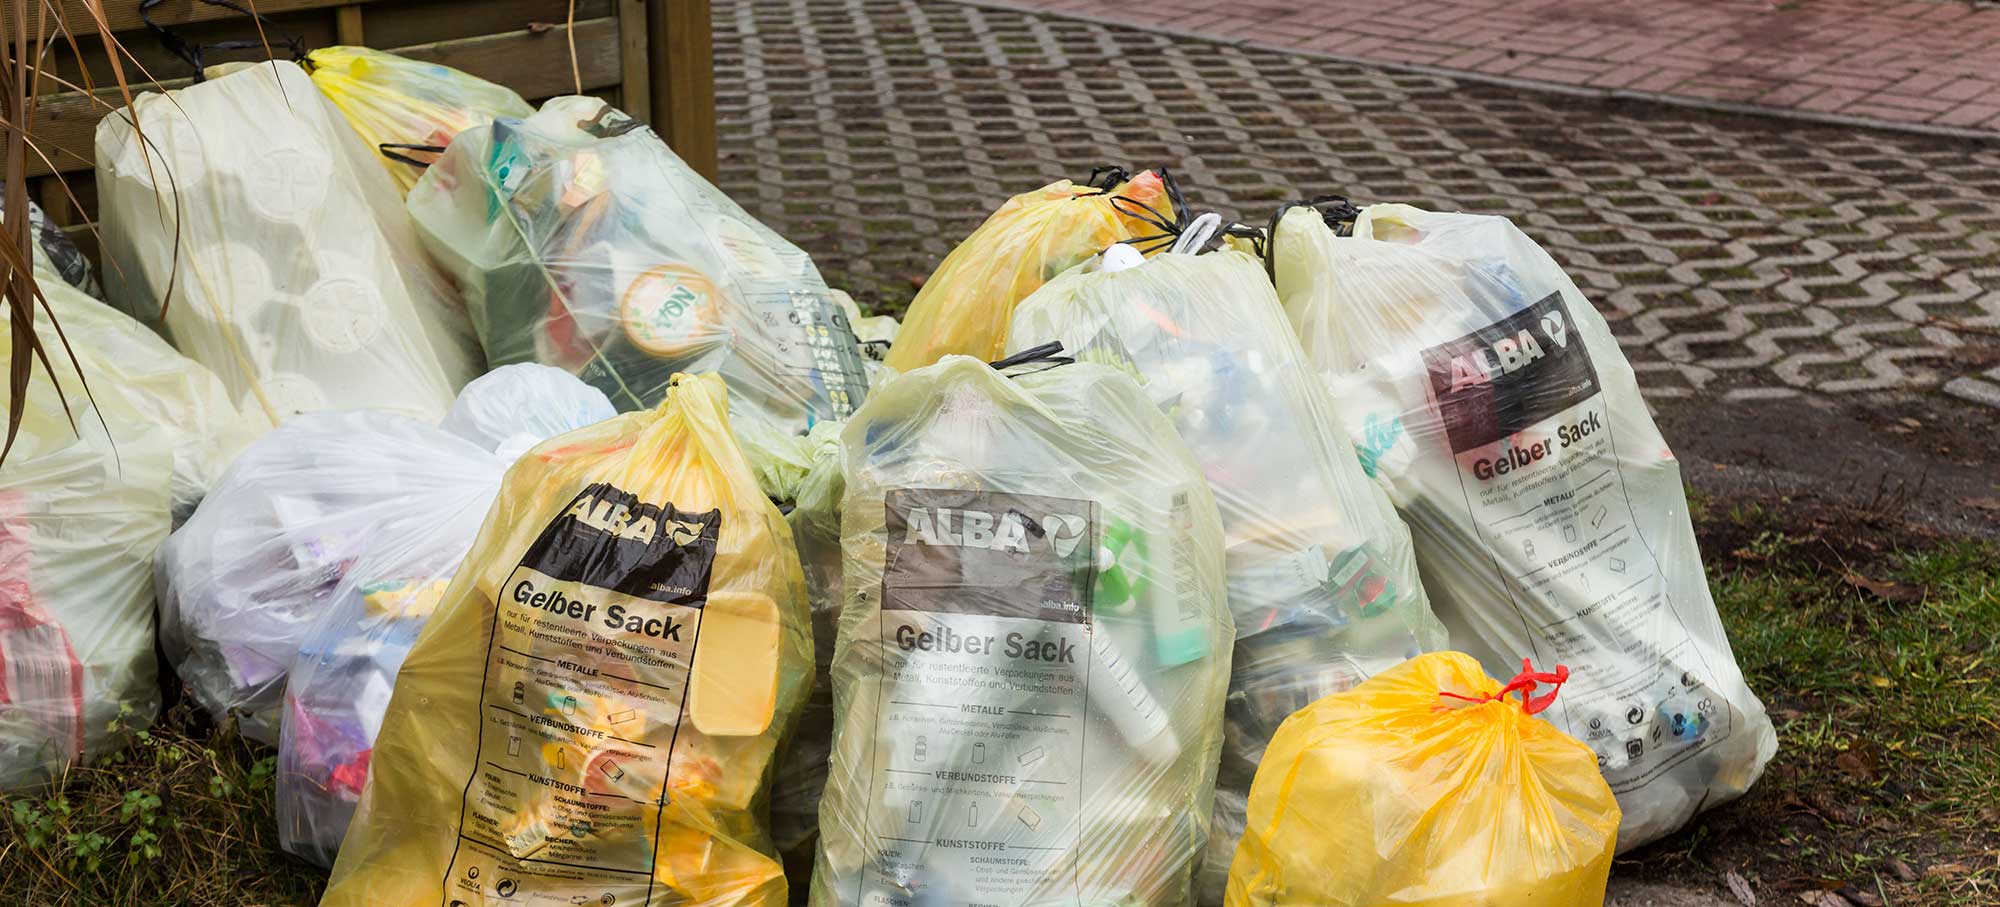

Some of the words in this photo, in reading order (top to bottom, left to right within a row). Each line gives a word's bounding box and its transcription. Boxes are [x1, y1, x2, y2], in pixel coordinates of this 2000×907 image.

[1450, 328, 1546, 393] ALBA
[1473, 437, 1552, 481] Gelber
[1557, 411, 1601, 448] Sack
[565, 495, 657, 545] ALBA
[903, 507, 1030, 553] ALBA
[651, 582, 692, 597] alba.info
[513, 580, 597, 622] Gelber
[604, 604, 682, 642] Sack
[504, 620, 526, 636] Metall,
[528, 628, 583, 649] Kunststoffen
[586, 644, 602, 655] und
[605, 647, 675, 670] Verbundstoffen
[507, 610, 518, 618] nur
[520, 613, 531, 623] für
[533, 619, 587, 638] restentleerte
[591, 632, 655, 654] Verpackungen
[660, 649, 677, 659] aus
[896, 624, 995, 655] Gelber
[1004, 632, 1075, 664] Sack
[557, 660, 599, 677] METALLE
[994, 666, 1055, 683] Verpackungen
[989, 680, 1005, 690] und
[961, 703, 1005, 715] METALLE
[529, 714, 604, 740] VERBUNDSTOFFE
[528, 773, 586, 796] KUNSTSTOFFE
[935, 770, 1016, 784] VERBUNDSTOFFE
[554, 795, 610, 811] SCHAUMSTOFFE:
[936, 838, 1005, 851] KUNSTSTOFFE
